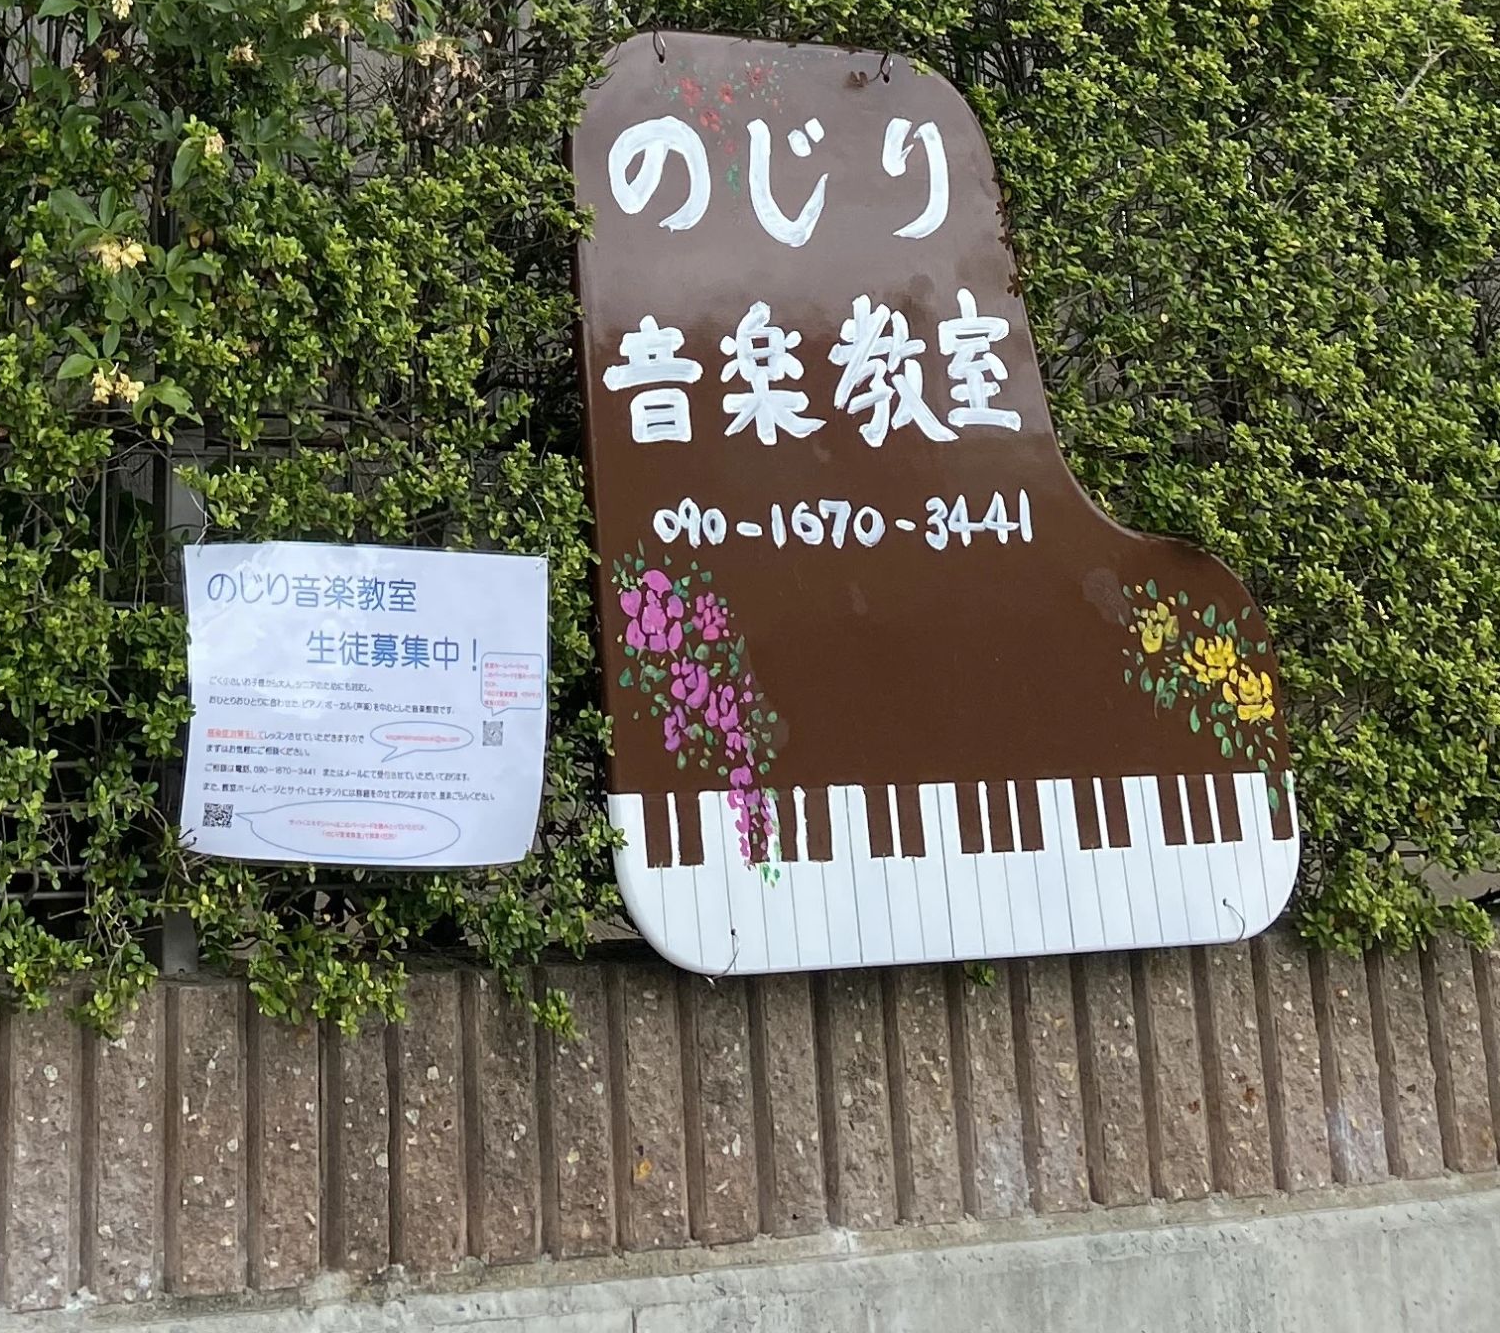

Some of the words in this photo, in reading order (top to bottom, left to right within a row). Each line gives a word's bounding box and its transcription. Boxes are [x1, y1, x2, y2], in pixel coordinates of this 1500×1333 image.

[607, 114, 950, 247] のじり
[601, 287, 1021, 447] 音楽教室
[652, 488, 1033, 550] 090-1670-3441
[206, 570, 418, 613] のじり音楽教室
